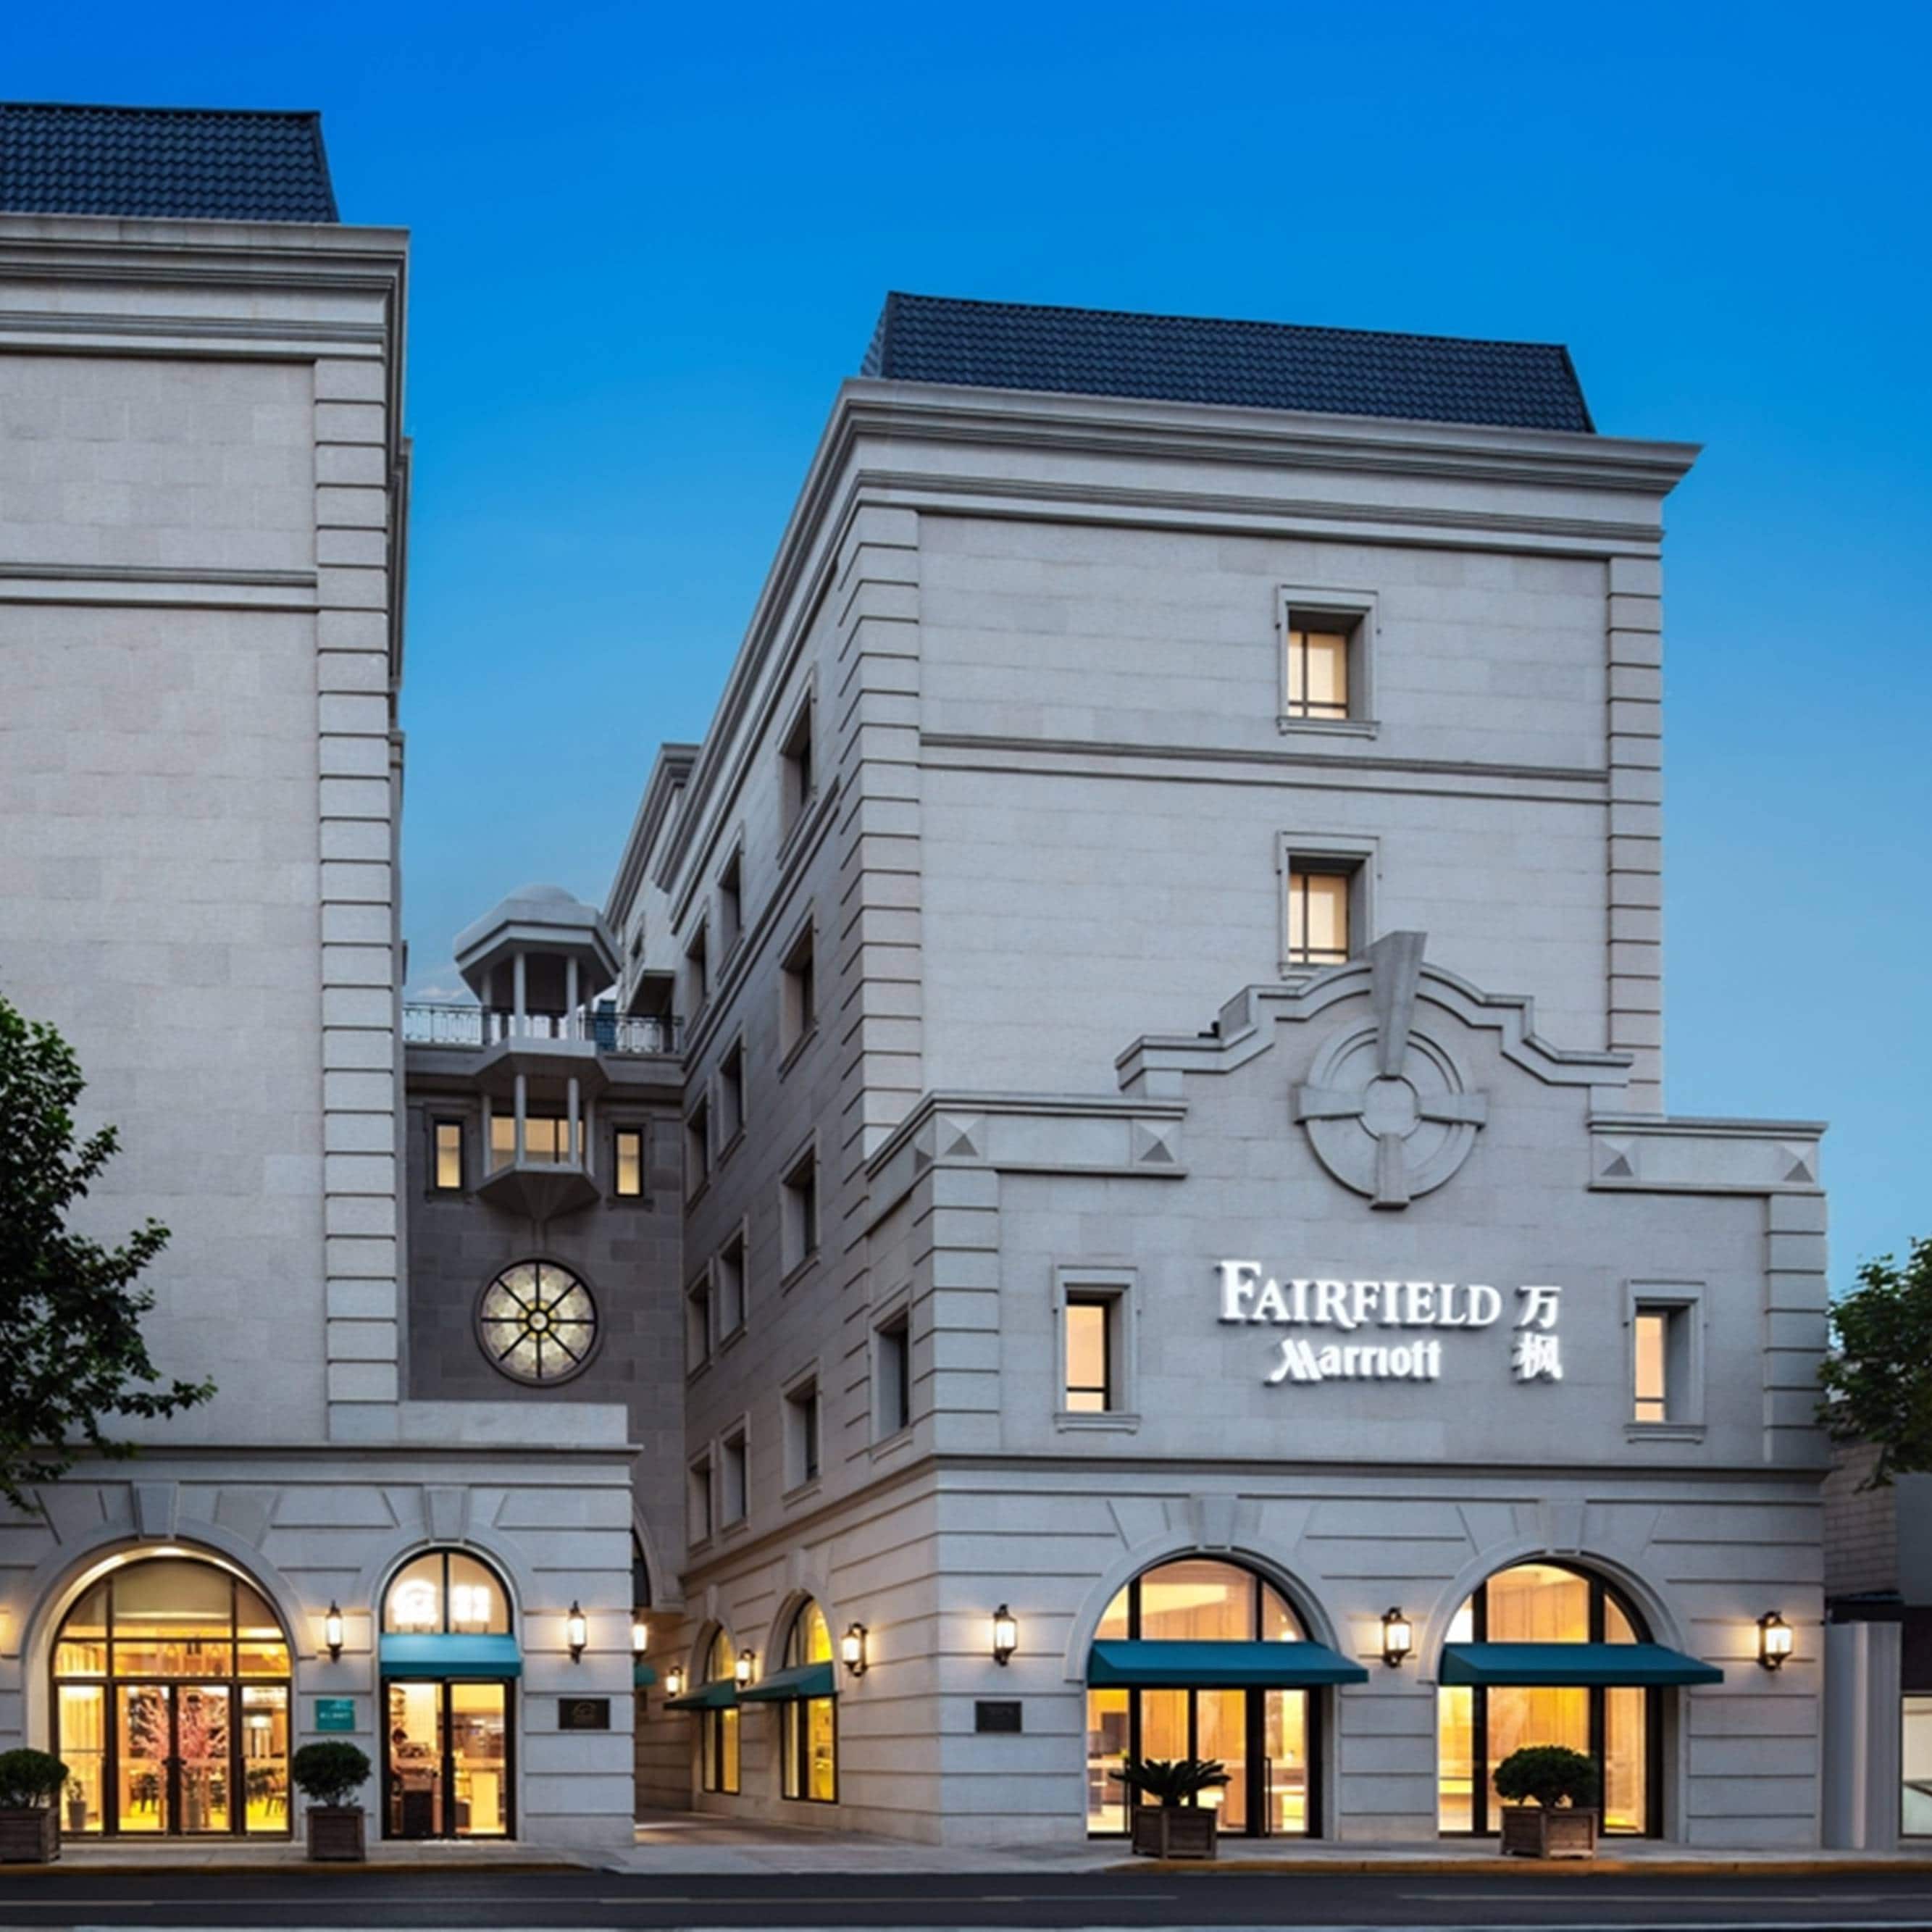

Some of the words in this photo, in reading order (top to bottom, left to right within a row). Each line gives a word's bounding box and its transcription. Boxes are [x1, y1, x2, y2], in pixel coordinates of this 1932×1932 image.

[1220, 1260, 1502, 1328] FAIRFIELD
[1269, 1338, 1442, 1382] Marriott
[1519, 1285, 1563, 1379] 万枫
